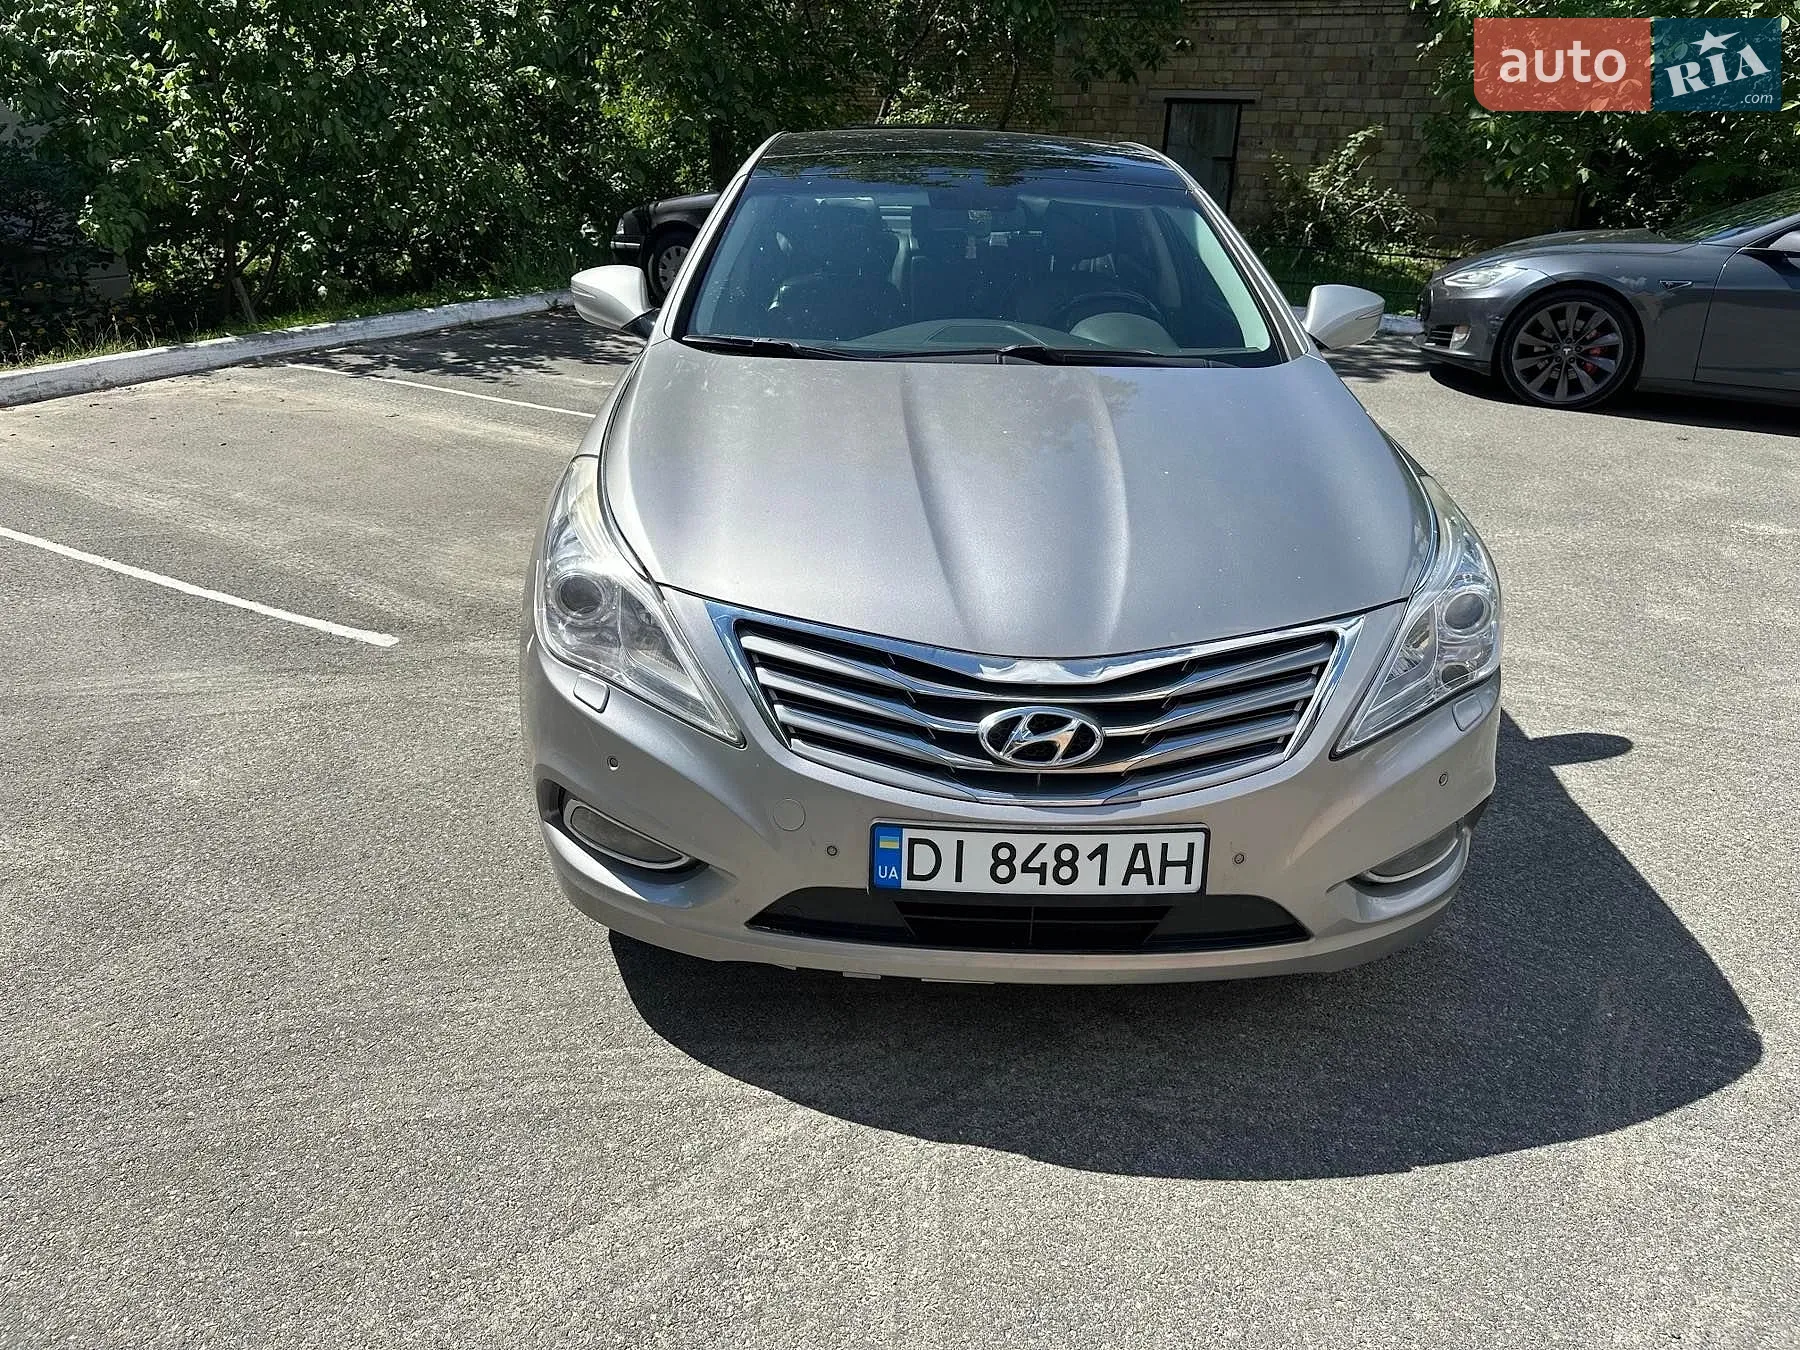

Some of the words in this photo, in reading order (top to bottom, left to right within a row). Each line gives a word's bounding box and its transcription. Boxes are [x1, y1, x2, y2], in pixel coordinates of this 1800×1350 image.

[878, 865, 899, 879] UA
[906, 837, 964, 883] DI
[989, 841, 1108, 886] 8481
[1121, 842, 1195, 886] AH
